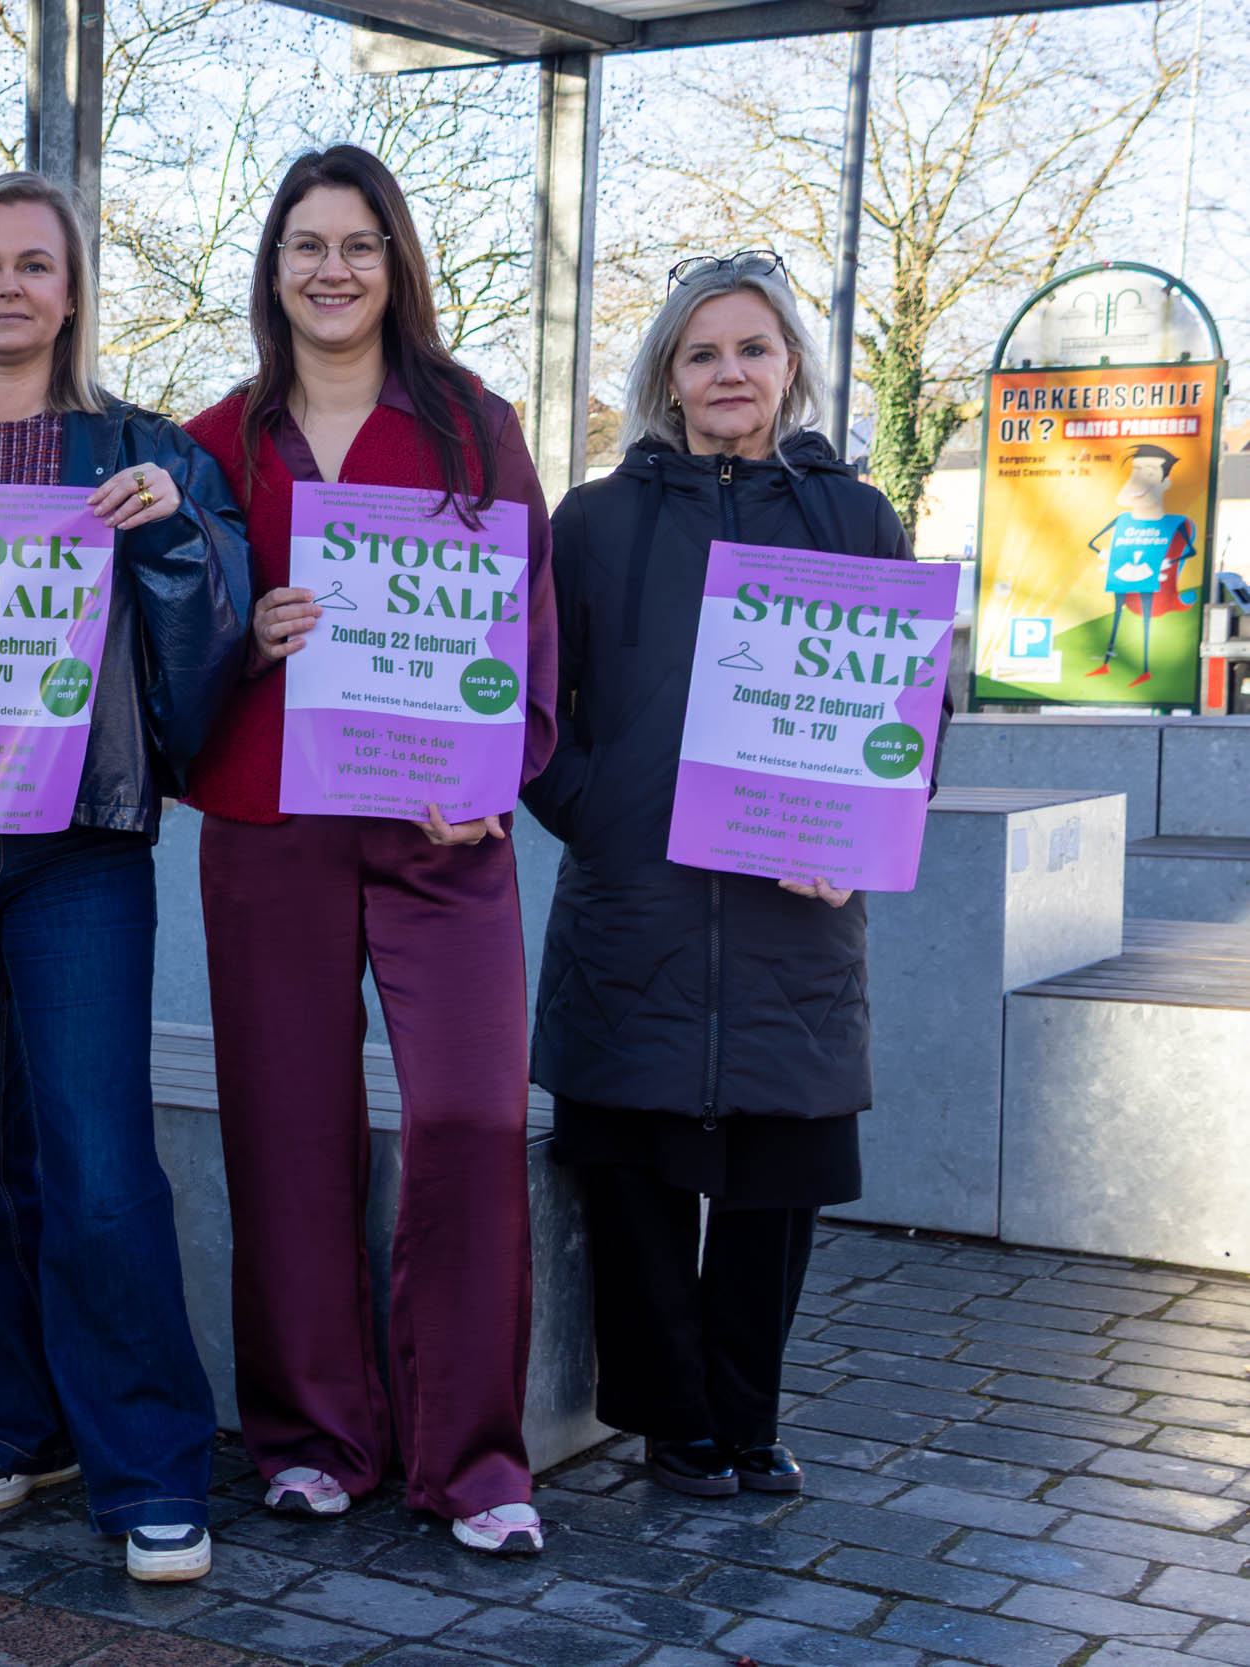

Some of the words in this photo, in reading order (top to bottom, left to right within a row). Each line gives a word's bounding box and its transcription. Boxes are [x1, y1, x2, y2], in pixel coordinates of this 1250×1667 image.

[1002, 382, 1205, 412] PARKEERSCHIJF
[1065, 419, 1119, 438] GRATIS
[1121, 418, 1198, 437] PARKEREN
[1115, 536, 1168, 547] parkeren
[1124, 527, 1160, 538] Gratis
[323, 521, 501, 575] STOCK
[387, 574, 520, 623] SALE
[733, 582, 921, 640] STOCK
[331, 625, 386, 649] Zondag
[391, 632, 409, 649] 22
[414, 633, 476, 656] februari
[1014, 620, 1047, 656] P
[793, 636, 935, 687] SALE
[46, 677, 67, 686] cash
[68, 678, 75, 686] &
[78, 678, 88, 688] pq
[466, 675, 488, 685] cash
[489, 677, 496, 685] &
[501, 678, 513, 688] pq
[478, 688, 501, 698] only!
[57, 690, 78, 699] only!
[341, 691, 361, 702] Met
[364, 694, 400, 706] Heistse
[403, 697, 462, 713] handelaars:
[732, 684, 790, 710] Zondag
[794, 694, 815, 713] 22
[819, 697, 885, 720] februari
[342, 726, 375, 739] Mooi
[386, 730, 416, 745] Tutti
[420, 737, 427, 746] e
[430, 736, 455, 750] due
[870, 739, 892, 749] cash
[894, 741, 902, 749] &
[905, 742, 918, 752] pq
[355, 746, 380, 758] LOF
[392, 749, 406, 761] Lo
[409, 752, 448, 767] Adoro
[736, 751, 756, 762] Met
[759, 754, 797, 767] Heistse
[800, 759, 863, 776] handelaars:
[881, 752, 905, 763] only!
[337, 763, 398, 778] VFashion
[409, 770, 460, 785] Bell'Ami
[734, 785, 767, 800] Mooi
[778, 792, 810, 807] Tutti
[814, 800, 822, 808] e
[826, 799, 852, 813] due
[745, 804, 770, 818] LOF
[782, 811, 797, 824] Lo
[800, 815, 843, 829] Adoro
[726, 820, 786, 840] VFashion
[798, 832, 854, 849] Bell'Ami
